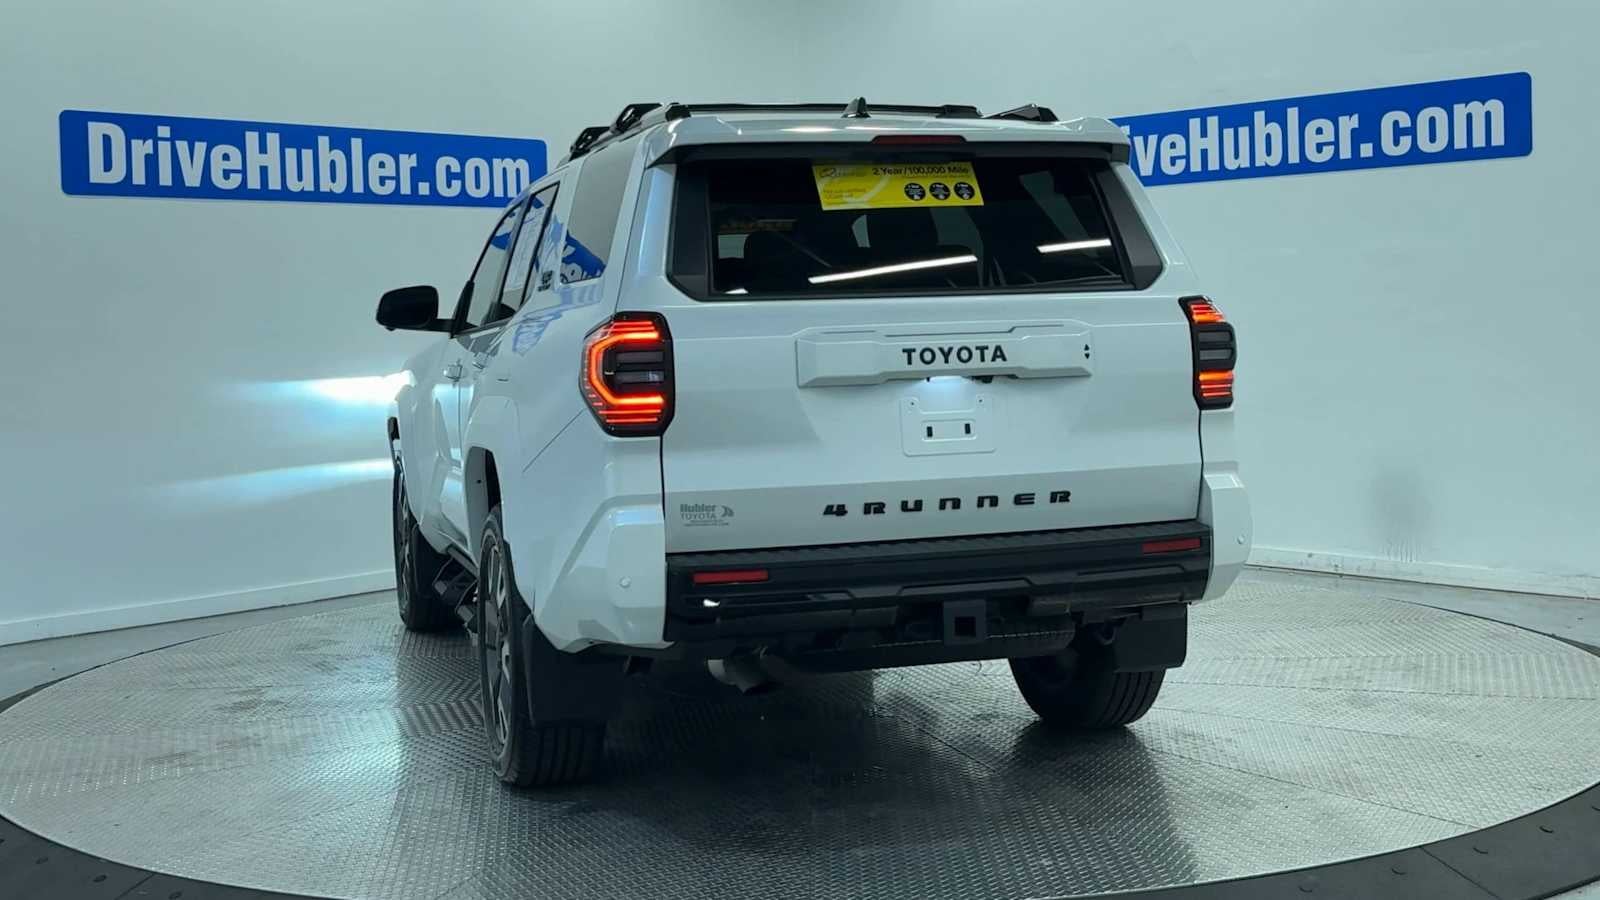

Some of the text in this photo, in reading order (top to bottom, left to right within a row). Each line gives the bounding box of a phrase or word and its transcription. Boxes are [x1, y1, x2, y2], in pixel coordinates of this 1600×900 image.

[87, 121, 530, 199] DriveHubler.com
[872, 167, 880, 176] 2
[901, 344, 1008, 366] TOYOTA
[680, 503, 717, 513] Hubler
[822, 490, 1073, 517] 4RUNNER
[680, 512, 717, 521] TOYOTA
